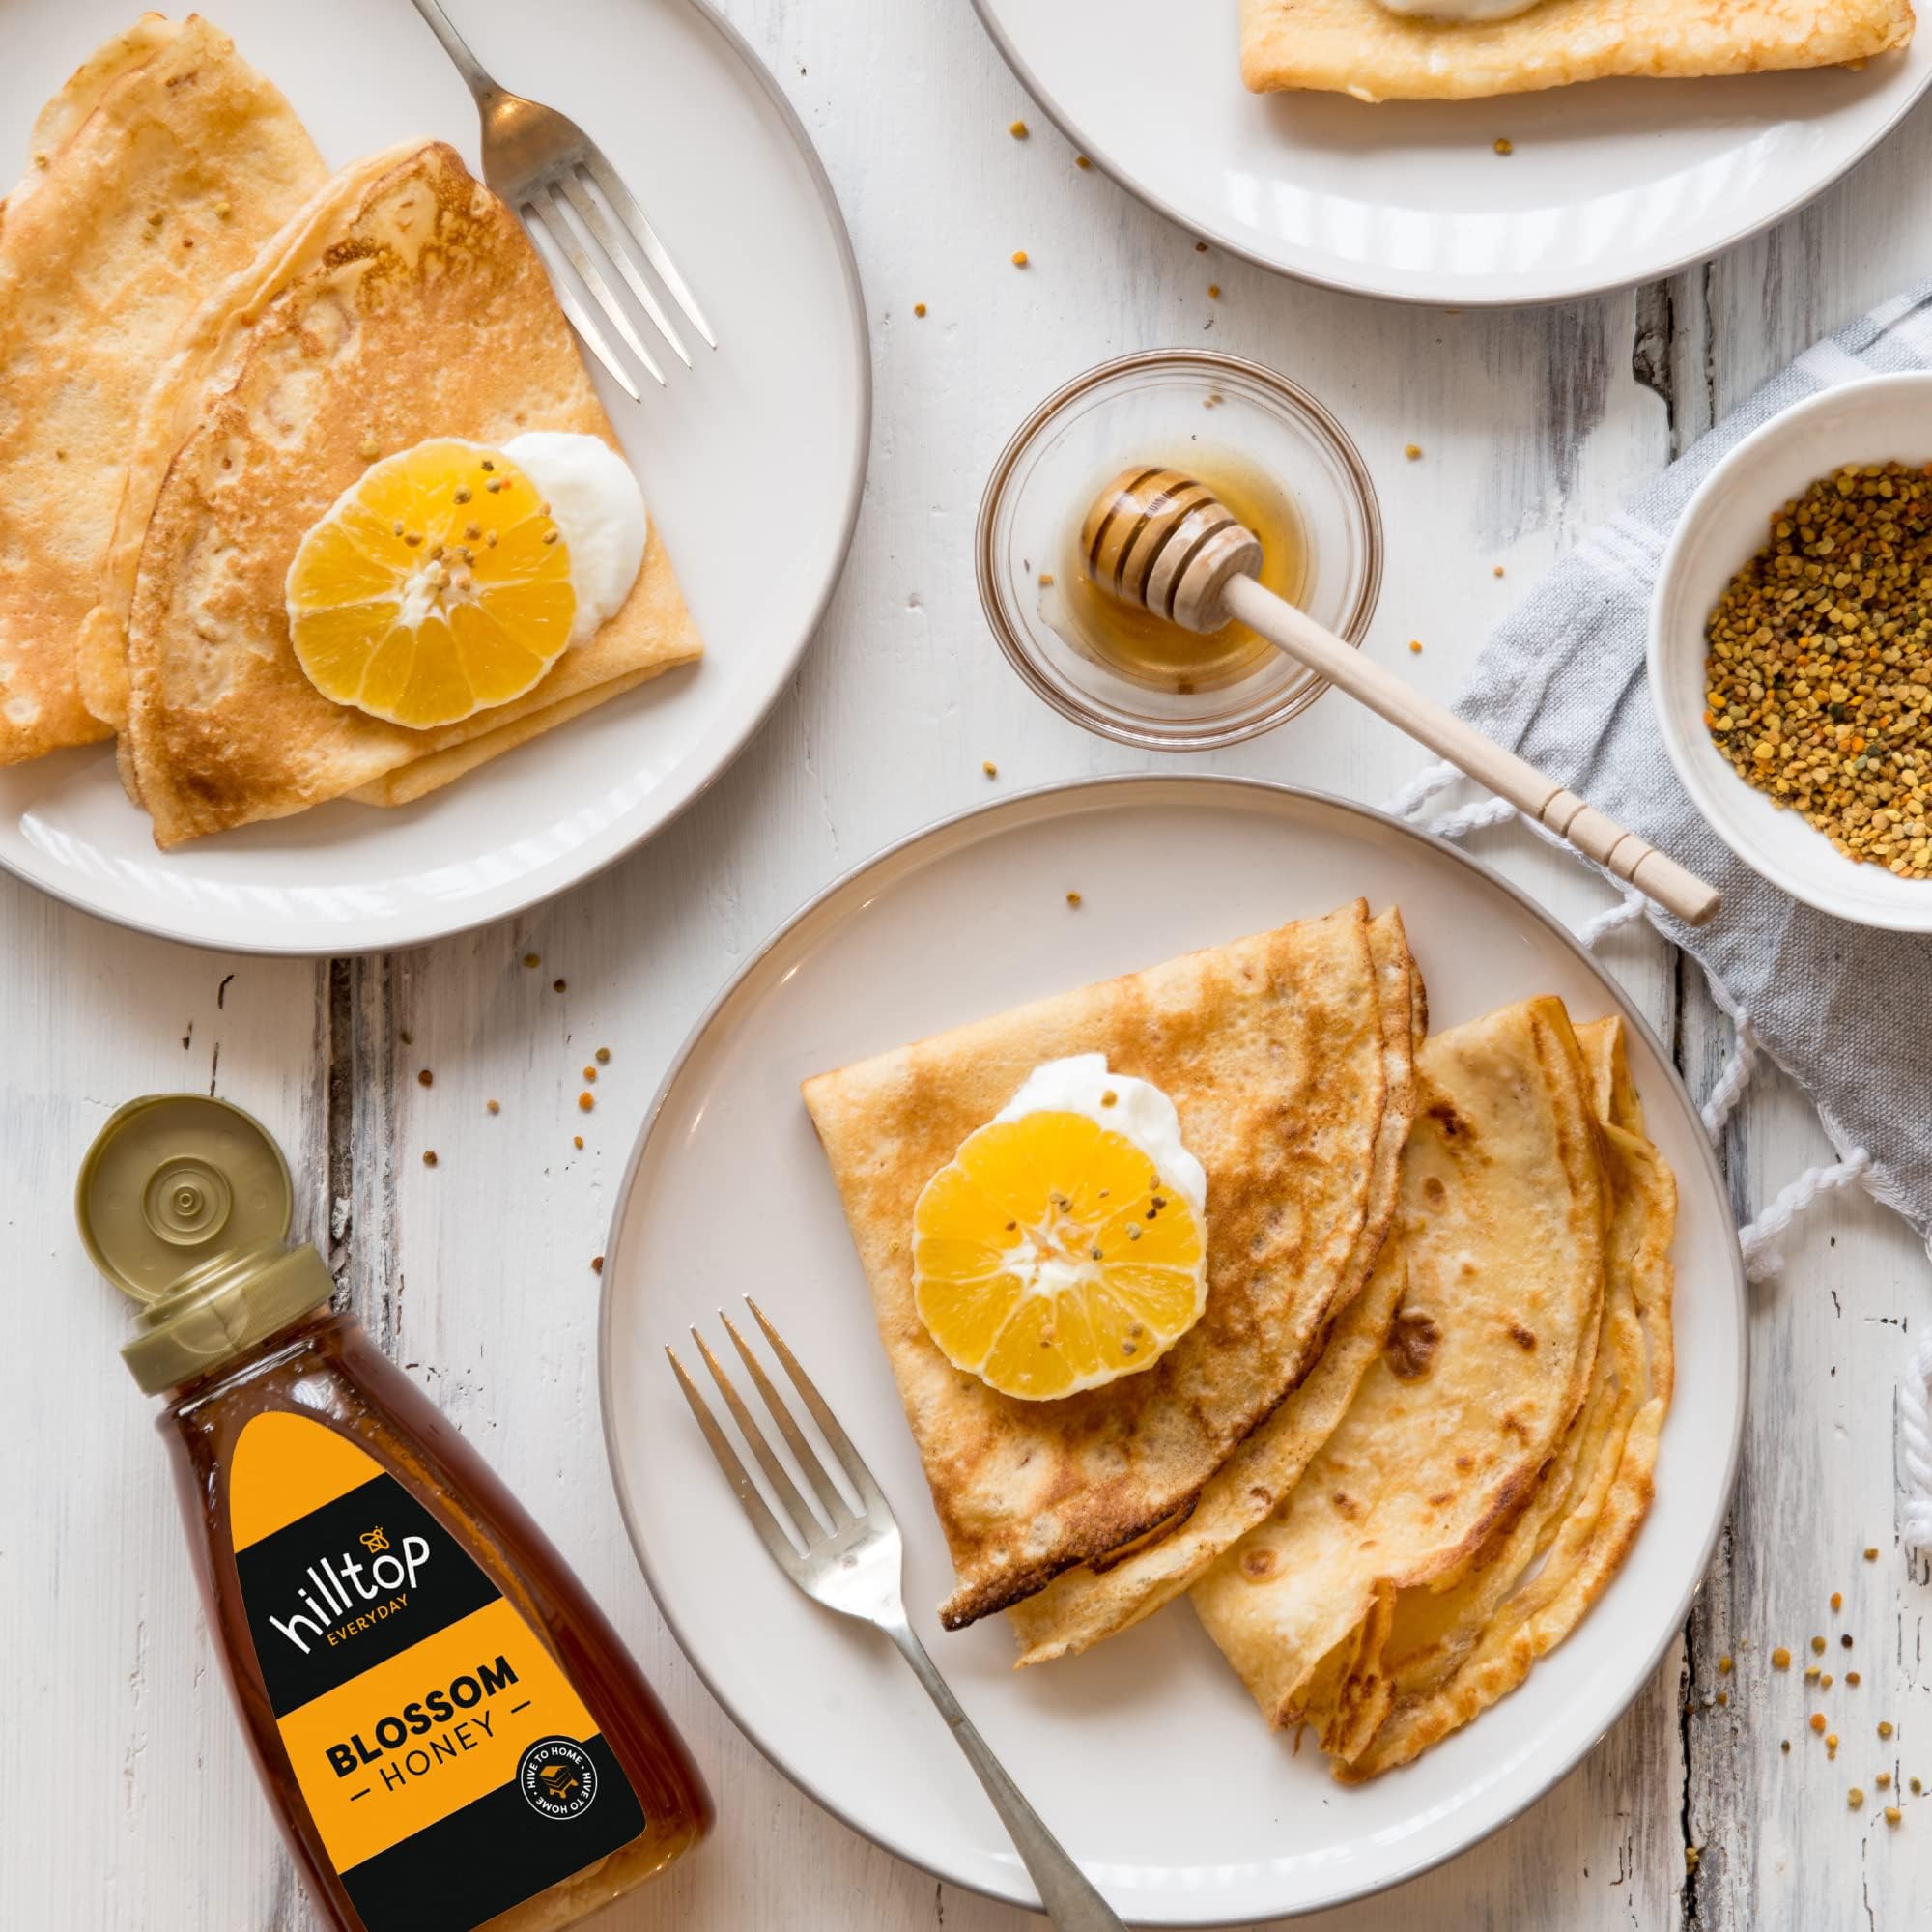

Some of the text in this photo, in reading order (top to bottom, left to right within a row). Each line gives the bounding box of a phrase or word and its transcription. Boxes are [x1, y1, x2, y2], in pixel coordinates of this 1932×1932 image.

[269, 1536, 431, 1655] hilltop
[327, 1593, 410, 1647] EVERYDAY
[325, 1655, 519, 1778] BLOSSOM
[379, 1711, 495, 1792] HONEY
[526, 1747, 583, 1789] HIVE TO HOME
[535, 1772, 592, 1814] HIVE TO HOME
